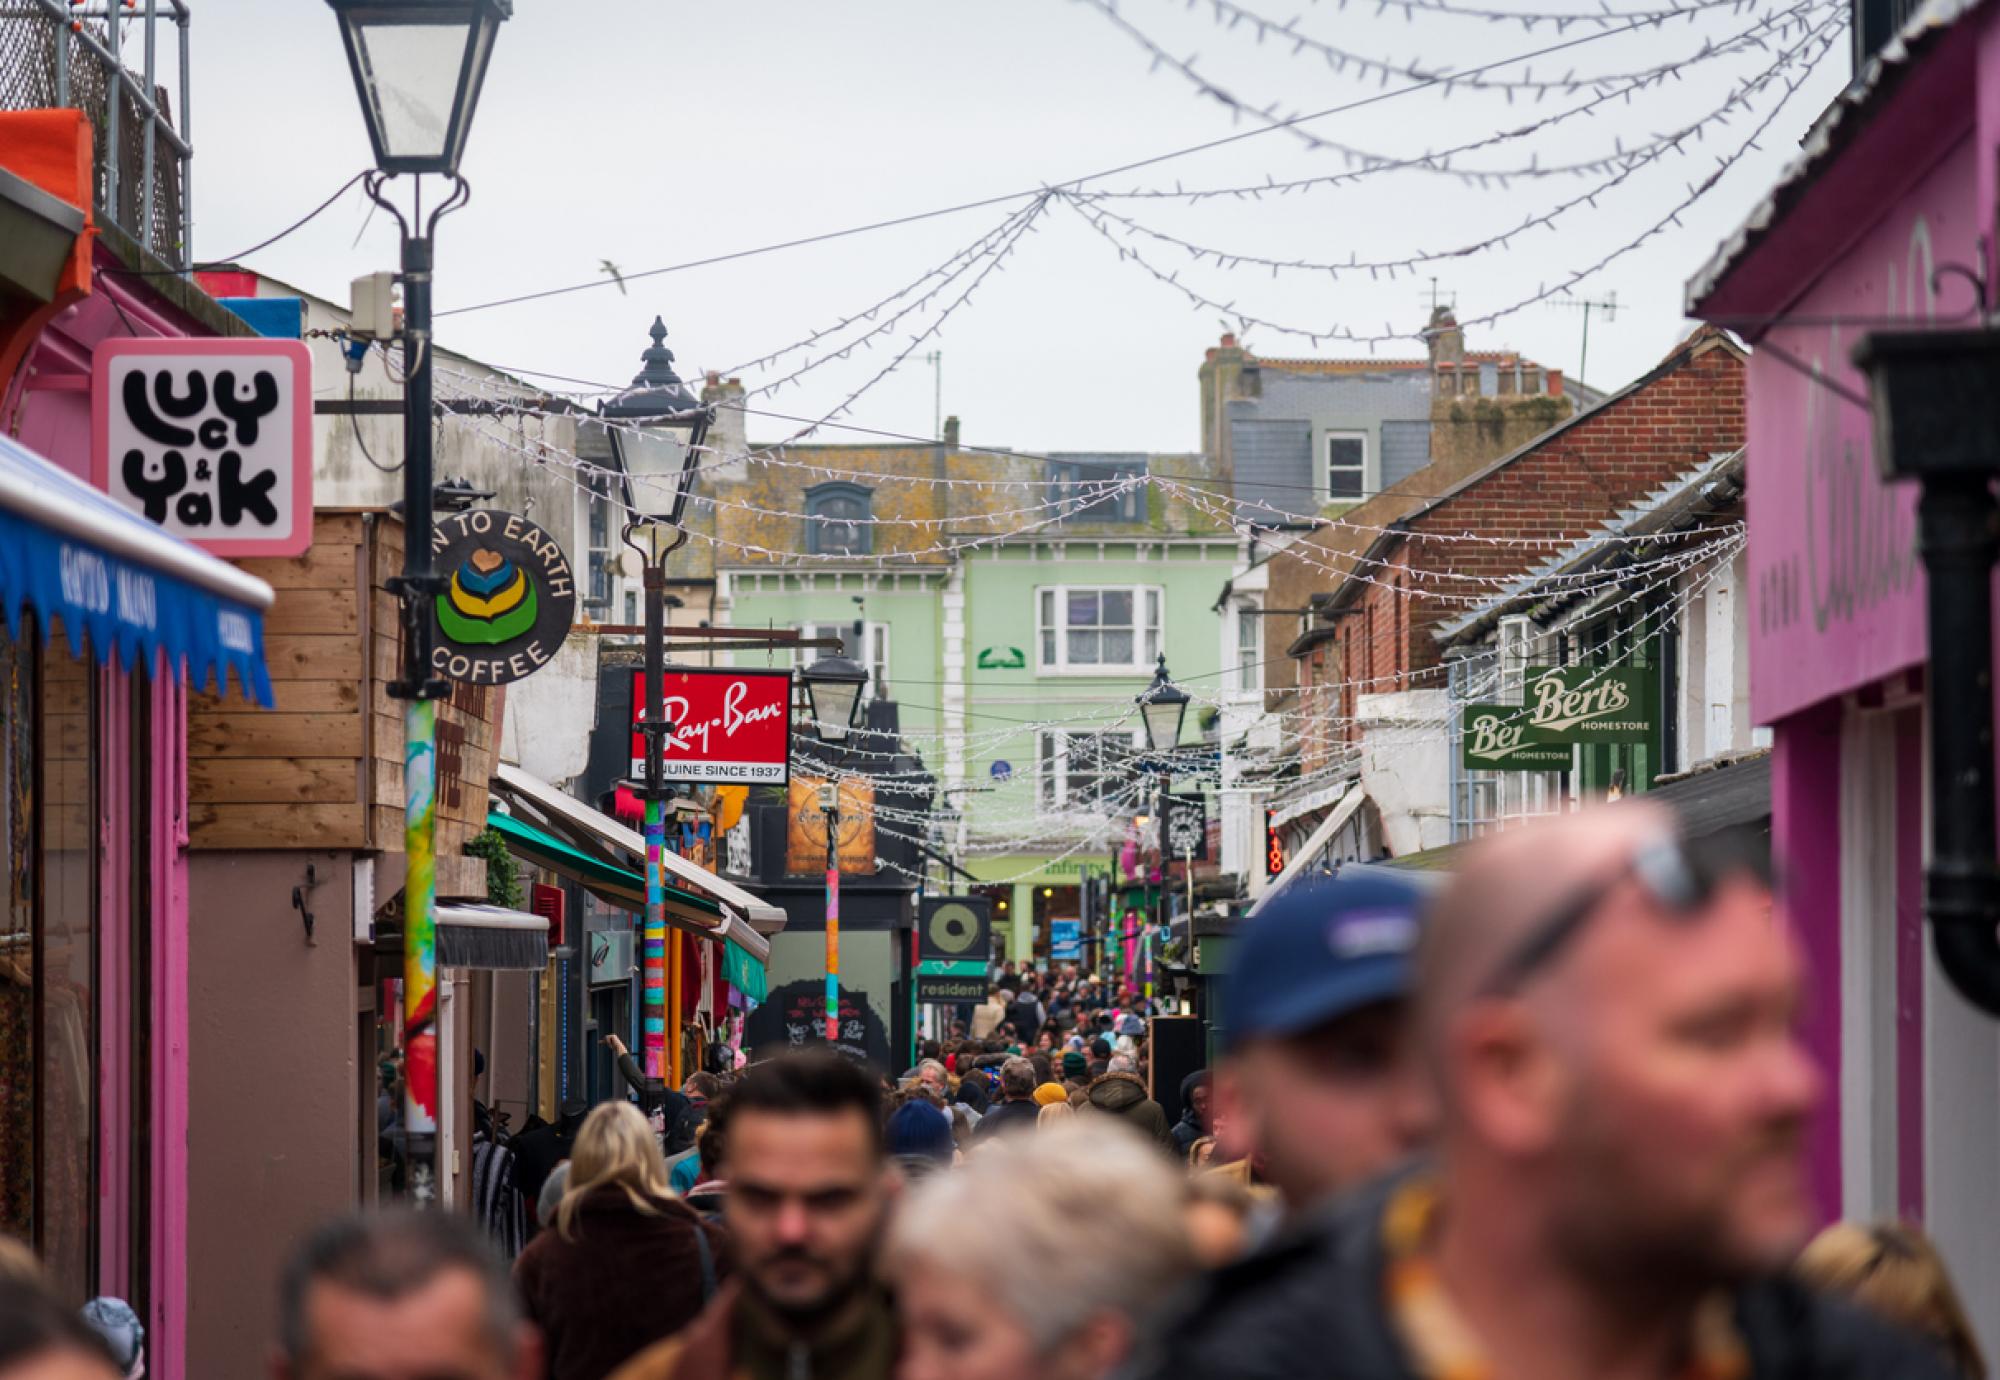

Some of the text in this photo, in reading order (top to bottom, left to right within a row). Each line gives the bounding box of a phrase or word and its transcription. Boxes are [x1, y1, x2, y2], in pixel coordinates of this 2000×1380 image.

[194, 458, 212, 481] &
[453, 511, 491, 537] TO
[503, 515, 573, 597] EARTH
[432, 640, 550, 683] COFFEE
[1529, 677, 1630, 726] Bert's
[1581, 720, 1650, 731] HOMESTORE
[1511, 751, 1569, 761] HOMESTORE
[705, 765, 748, 777] SINCE
[750, 767, 782, 778] 1937
[921, 983, 985, 997] resident
